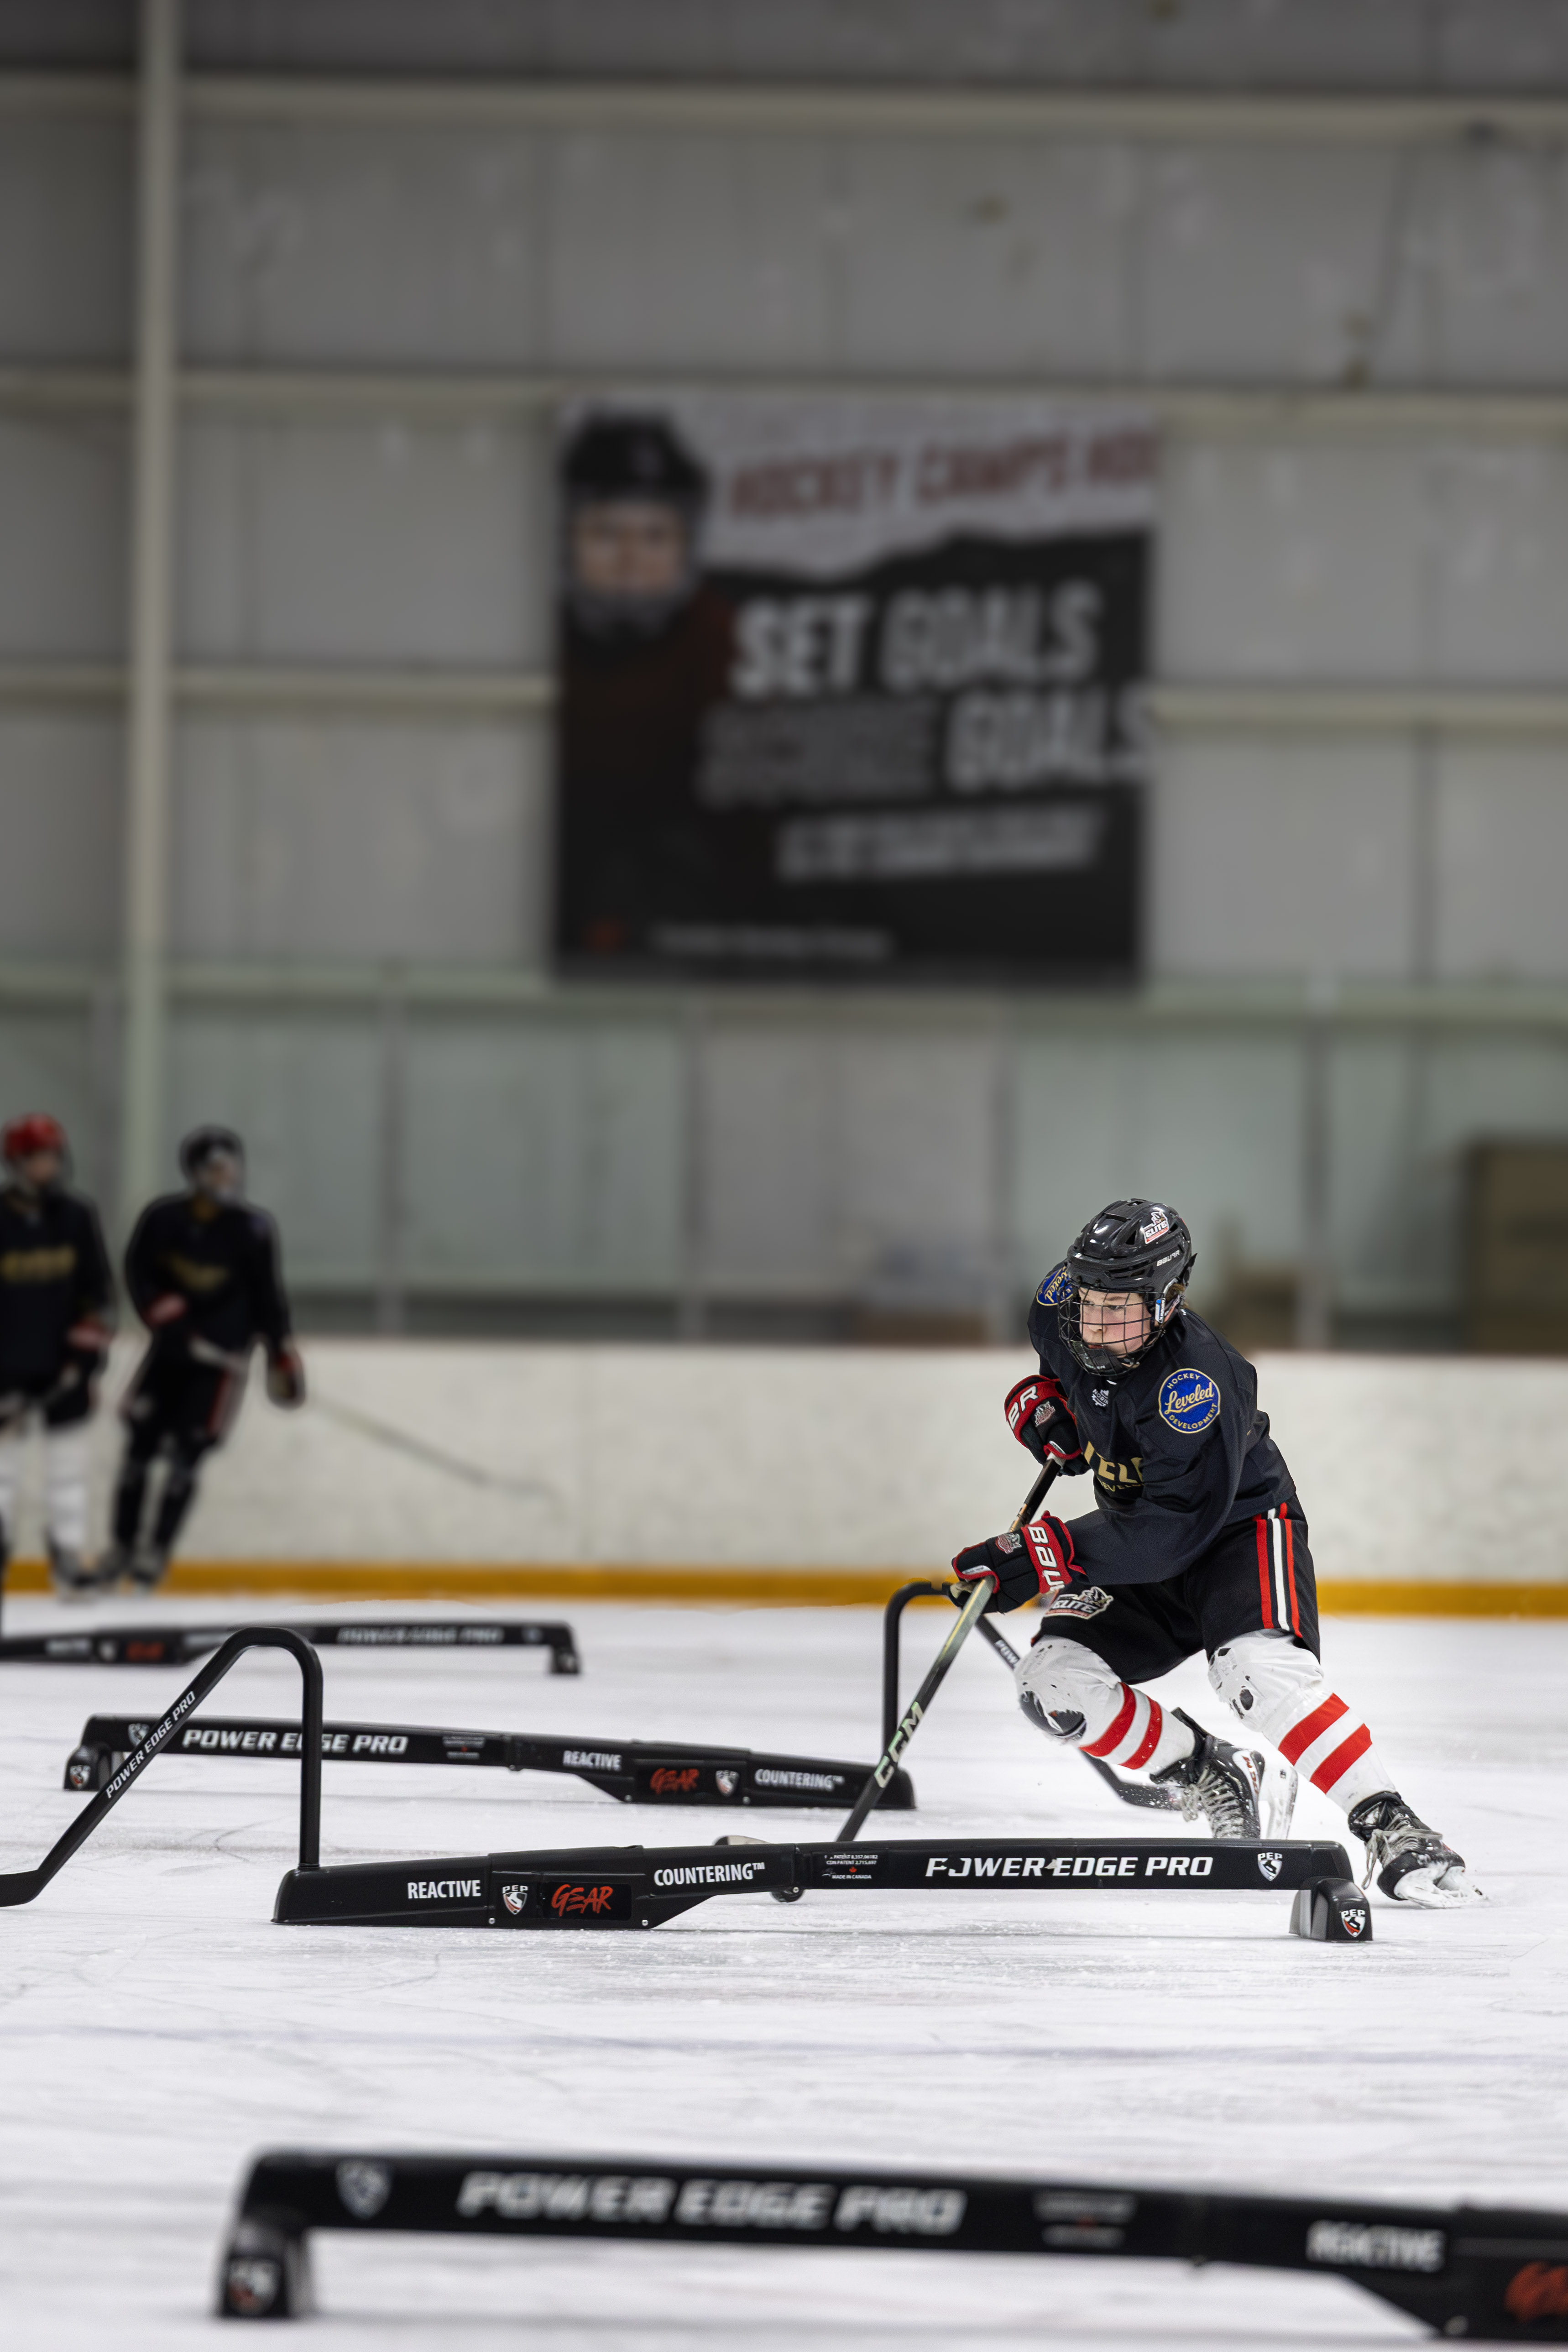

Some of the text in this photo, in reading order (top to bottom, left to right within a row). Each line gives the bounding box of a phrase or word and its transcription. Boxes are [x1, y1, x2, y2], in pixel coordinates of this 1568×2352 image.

[731, 580, 1102, 699] SET GOALS
[947, 680, 1158, 793] GOALS
[1167, 1373, 1200, 1389] HOCKEY
[1164, 1382, 1215, 1414] Leveled
[1169, 1403, 1218, 1430] DEVELOPMENT
[994, 1639, 1019, 1664] POW
[105, 1750, 145, 1798] POWER
[144, 1717, 173, 1753] EDGE
[172, 1690, 196, 1721] PRO
[182, 1729, 408, 1755] POWER EGE PRO
[874, 1701, 924, 1788] CCM
[563, 1750, 622, 1772] REACTIVE
[650, 1767, 699, 1795] GEAR
[1052, 1857, 1139, 1876] EDGE
[1145, 1857, 1213, 1876] PRO
[1258, 1852, 1283, 1861] PEP
[408, 1880, 481, 1899] REACTIVE
[502, 1885, 528, 1893] PEP
[551, 1884, 613, 1917] GEAR
[1341, 1909, 1365, 1918] PEP
[458, 2171, 968, 2235] POWER EDGE PRO
[1306, 2219, 1446, 2274] REACTIVE
